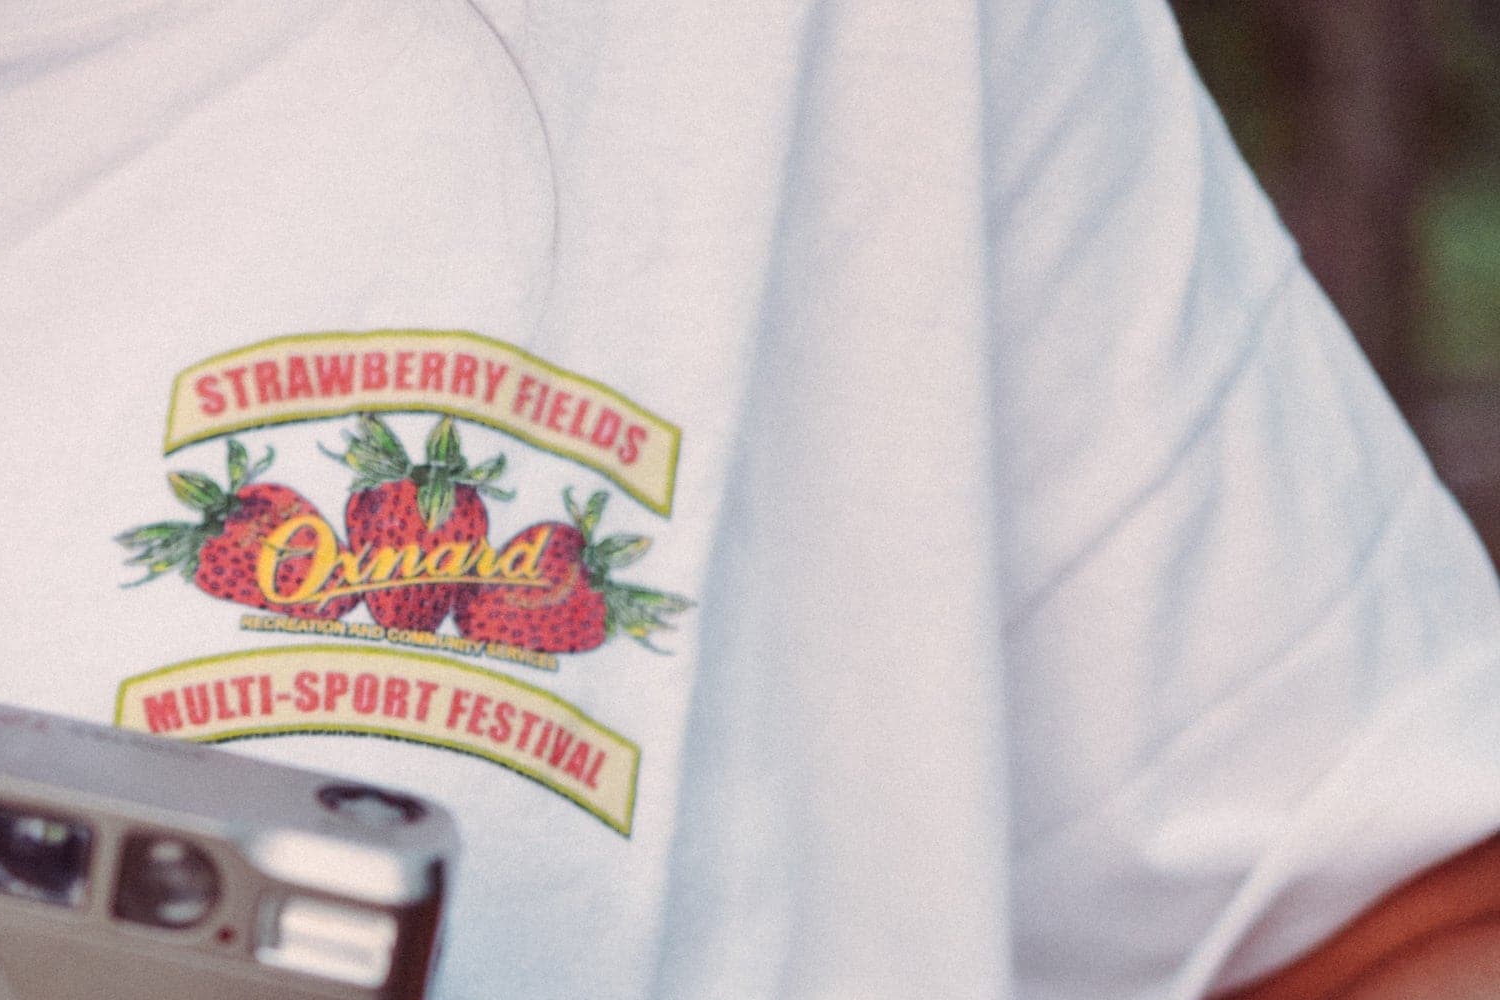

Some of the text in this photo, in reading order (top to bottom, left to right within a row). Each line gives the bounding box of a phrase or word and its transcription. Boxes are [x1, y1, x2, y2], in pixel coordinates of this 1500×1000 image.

[194, 351, 650, 468] STRAWBERRY FIELDS
[254, 514, 553, 604] Oxnard
[141, 672, 610, 791] MULTI-SPORT FESTIVAL
